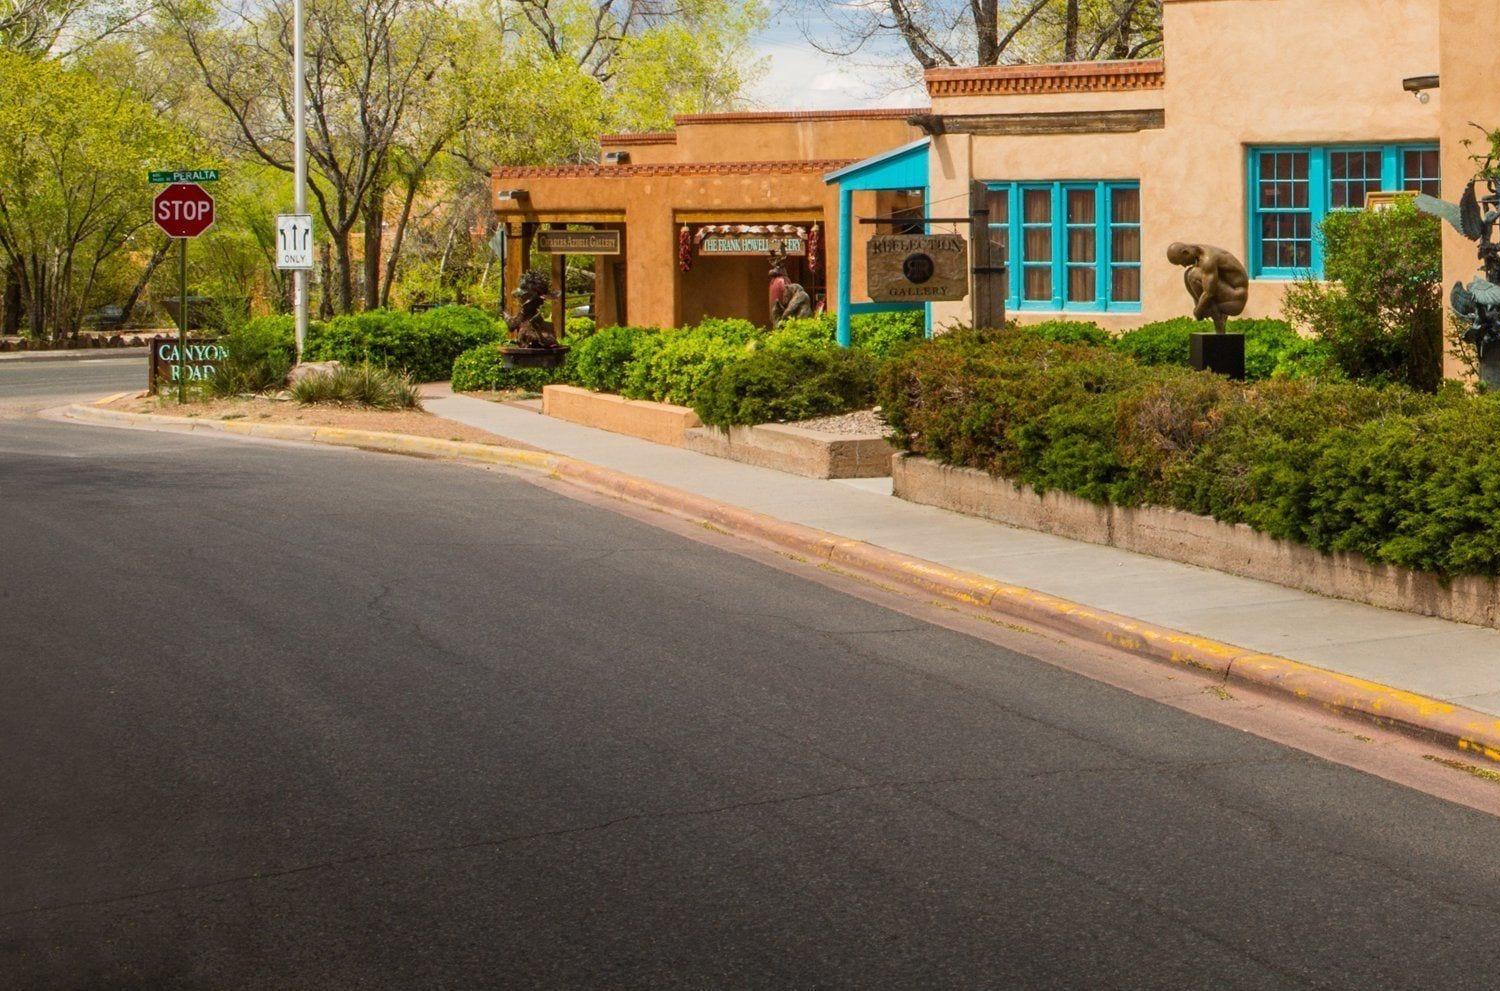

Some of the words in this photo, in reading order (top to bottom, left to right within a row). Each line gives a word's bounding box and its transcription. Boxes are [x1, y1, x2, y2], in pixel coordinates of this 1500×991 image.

[173, 170, 216, 181] PERALTA
[158, 200, 210, 221] STOP
[704, 238, 717, 251] THE
[719, 238, 741, 251] FRANK
[872, 239, 962, 254] REFLECTION
[284, 254, 306, 264] ONLY
[889, 286, 948, 297] GALLERY
[159, 344, 230, 361] CANYON
